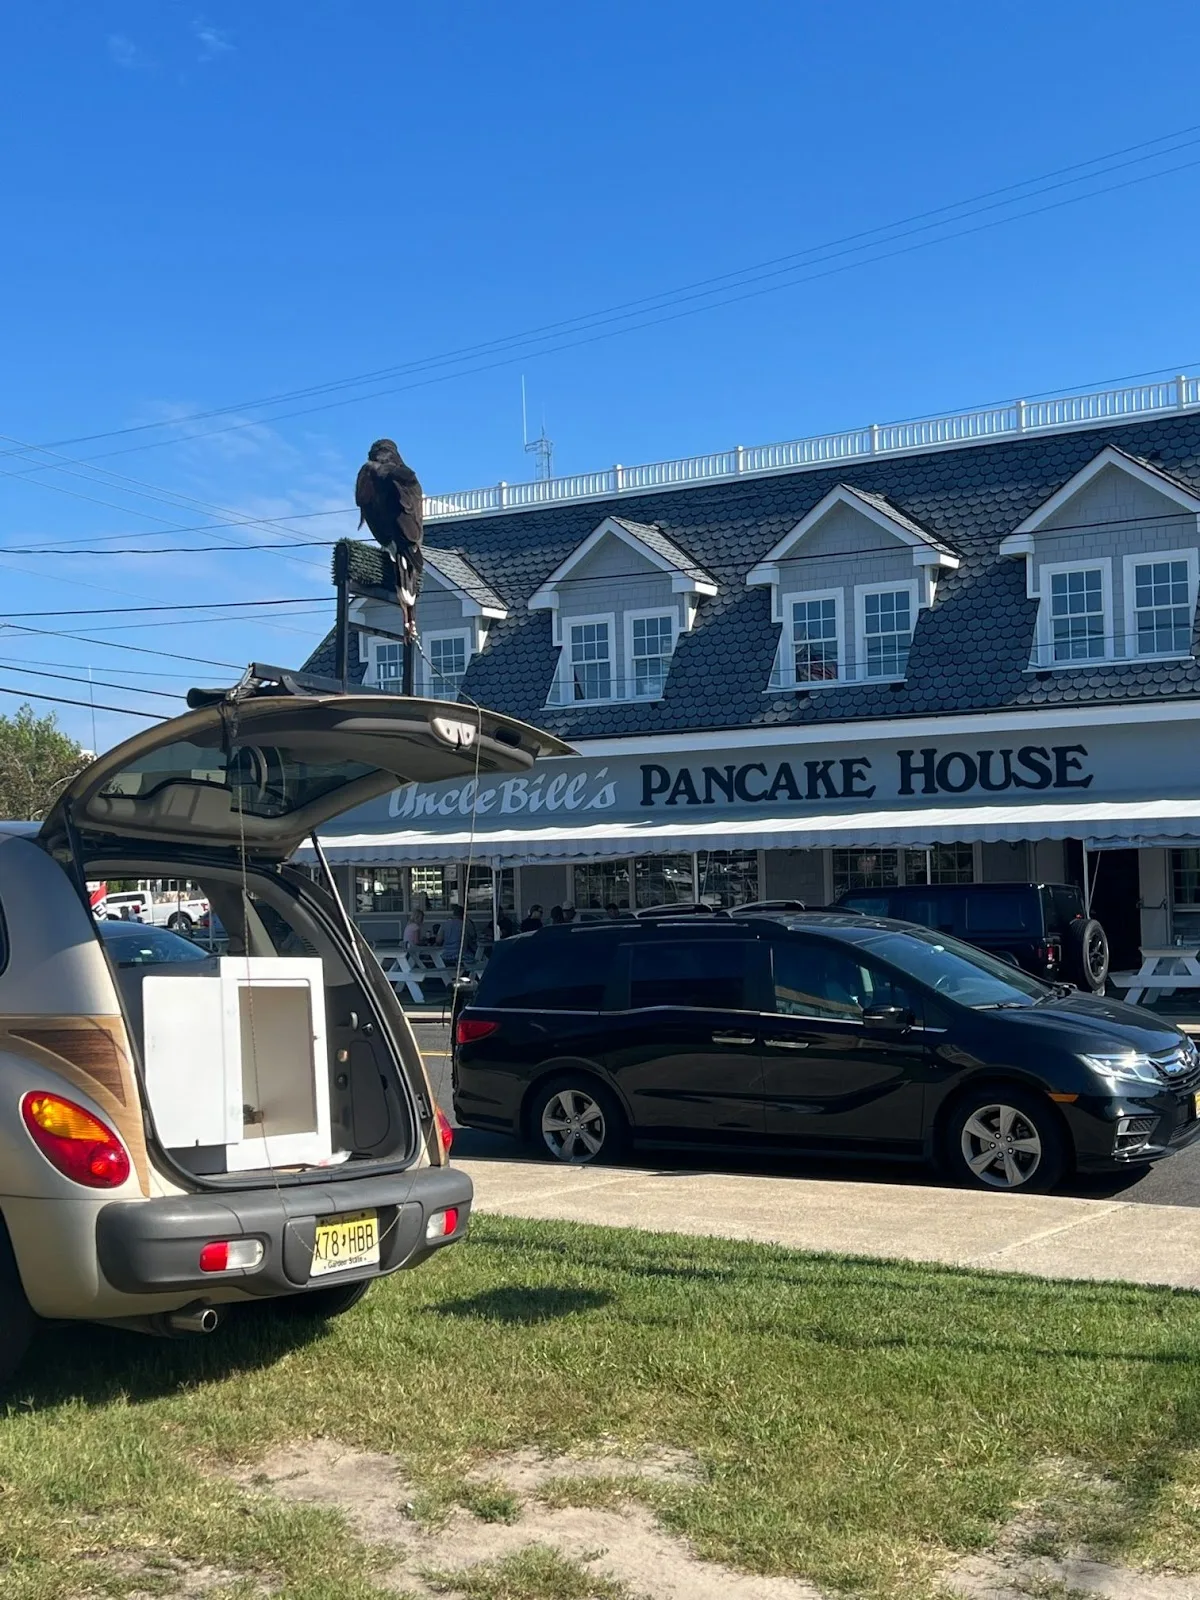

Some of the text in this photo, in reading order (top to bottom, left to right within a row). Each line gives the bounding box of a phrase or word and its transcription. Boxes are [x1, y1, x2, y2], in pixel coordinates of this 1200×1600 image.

[388, 744, 1095, 819] Uncle Bill's PANCAKE HOUSE
[348, 1224, 374, 1254] HBB
